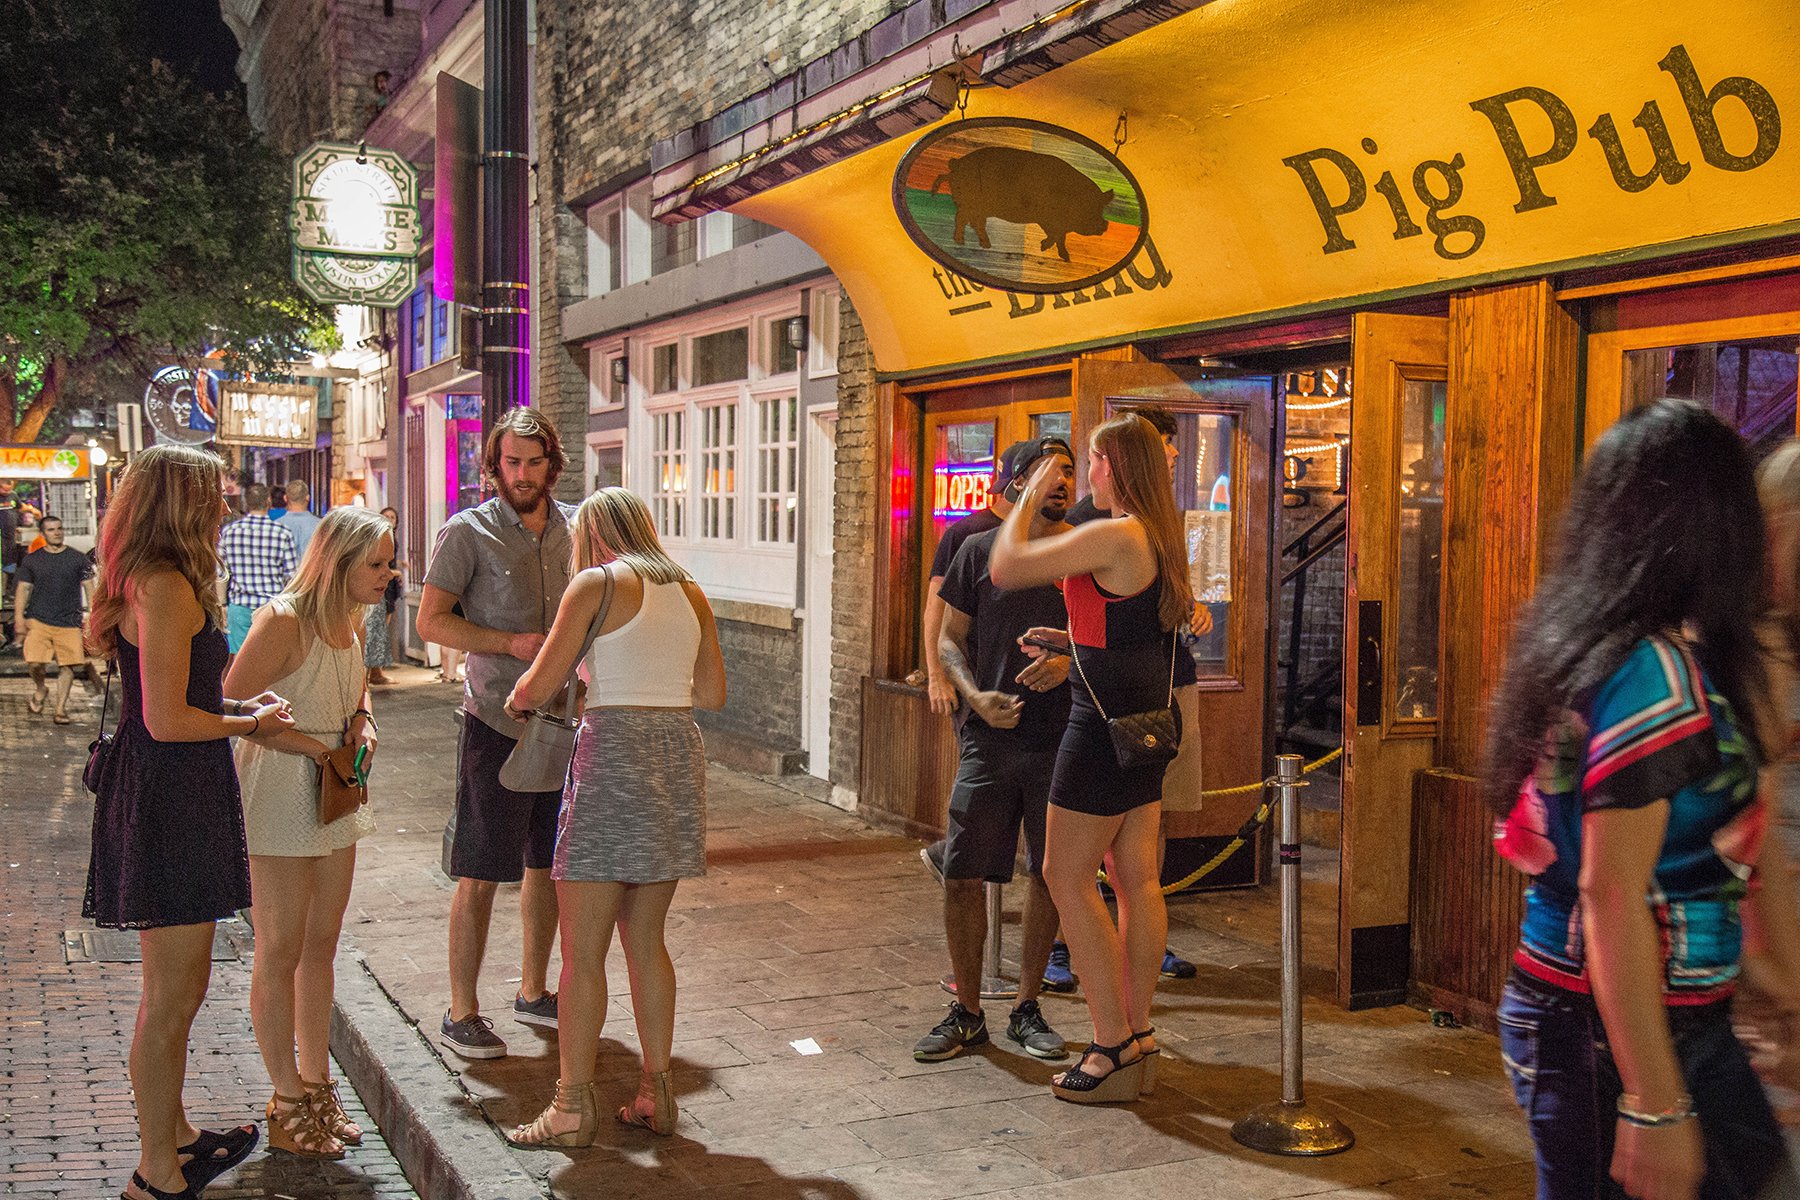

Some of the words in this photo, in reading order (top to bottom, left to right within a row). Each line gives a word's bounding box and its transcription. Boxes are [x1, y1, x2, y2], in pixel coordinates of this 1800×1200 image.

[1282, 136, 1486, 260] Pig
[1469, 43, 1782, 214] Pub
[320, 258, 358, 286] AUSTIN
